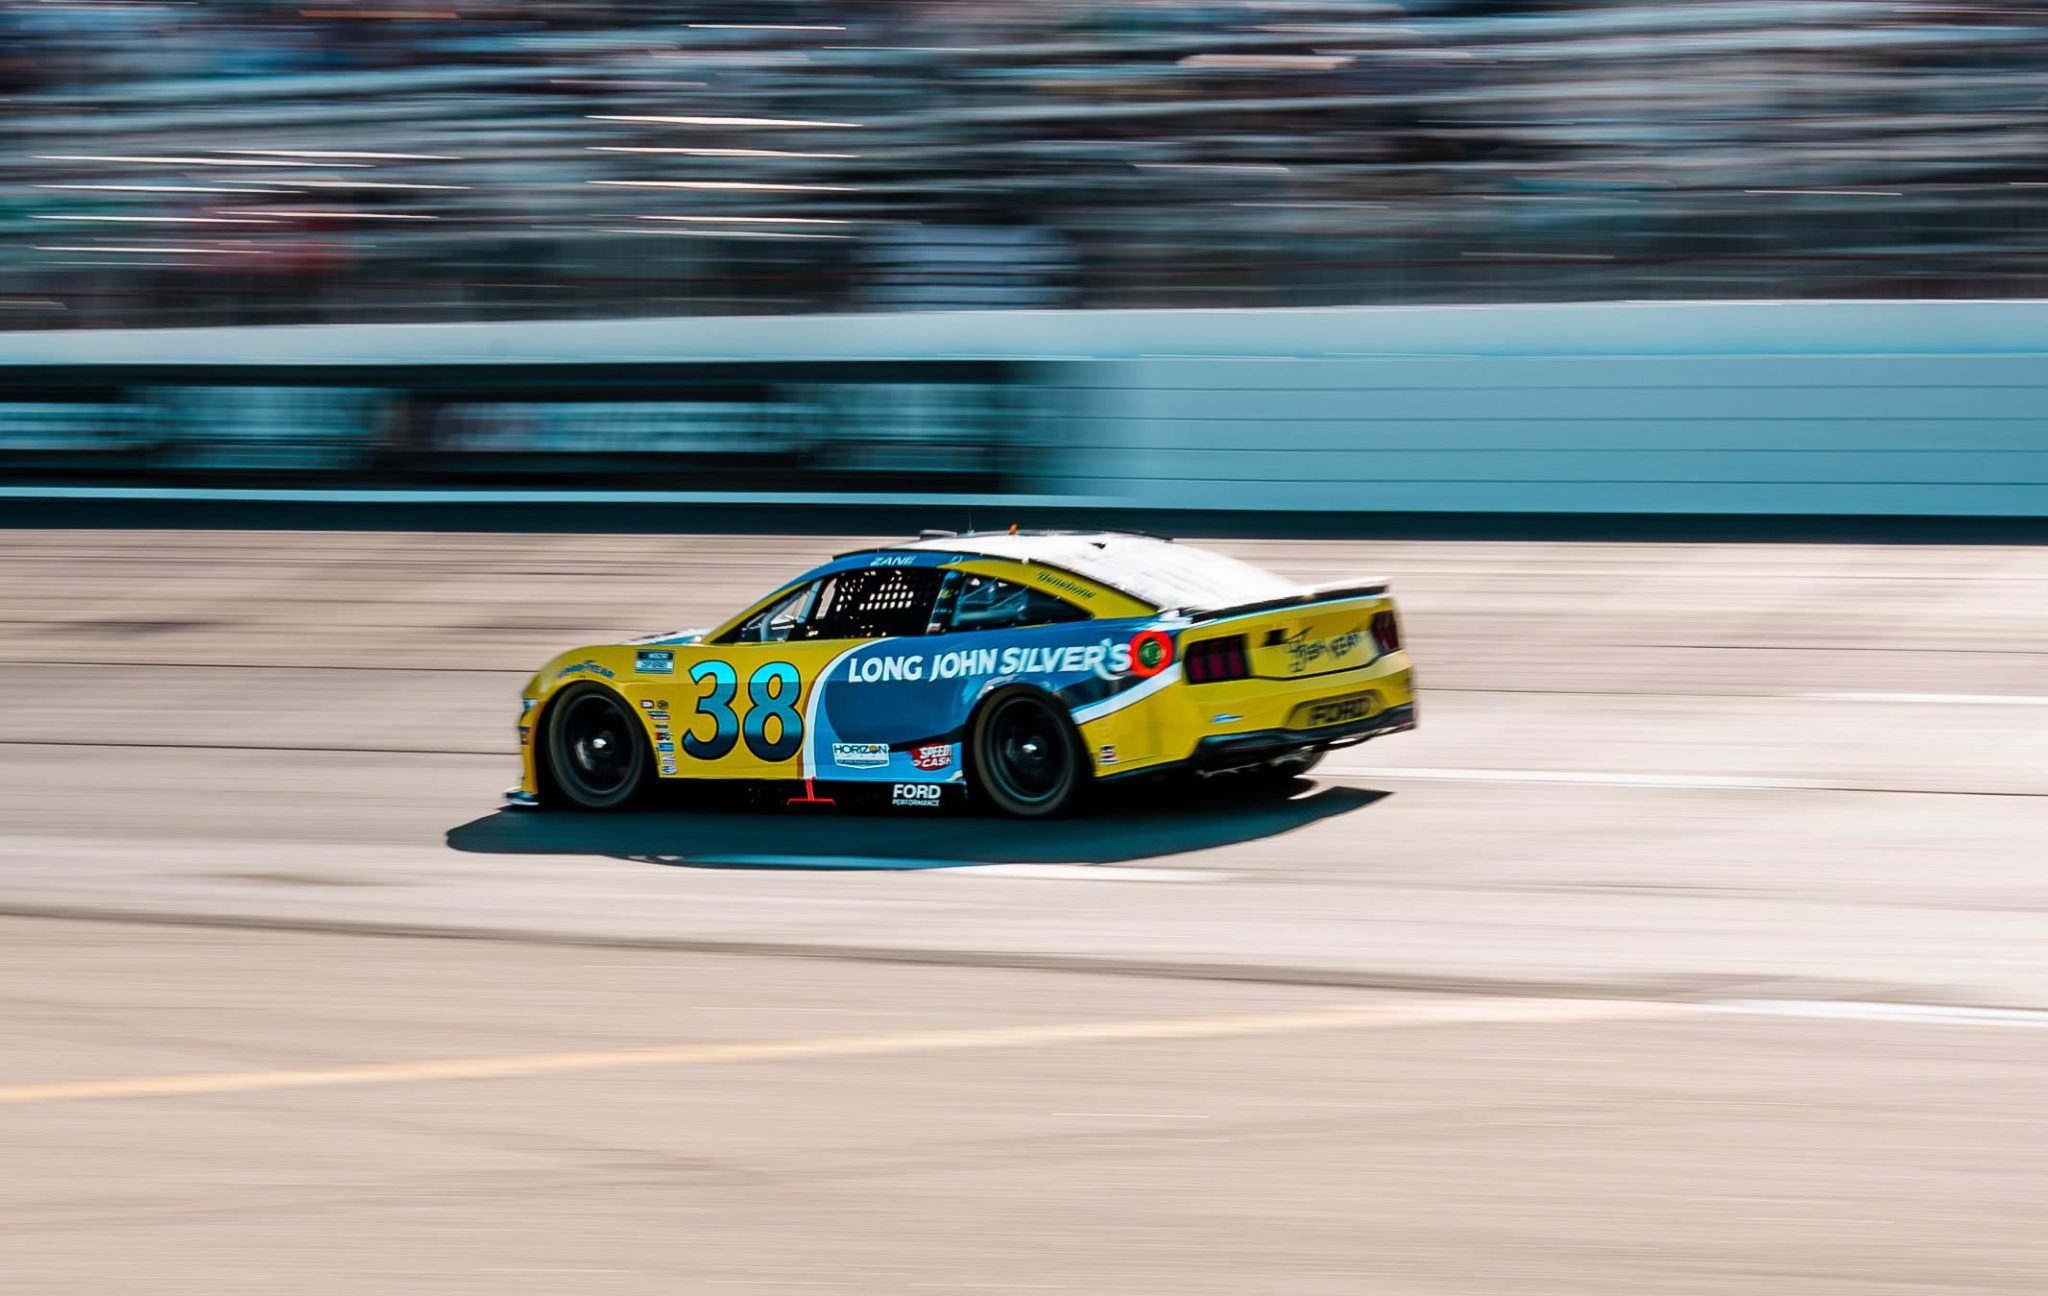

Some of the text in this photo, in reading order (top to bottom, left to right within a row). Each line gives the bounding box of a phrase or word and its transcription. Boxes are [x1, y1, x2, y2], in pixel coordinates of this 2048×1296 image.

[869, 555, 917, 567] ZANE
[848, 637, 1133, 683] LONG JOHN SILVER'S
[681, 659, 805, 763] 38
[1307, 697, 1372, 727] FORD
[834, 744, 888, 755] HORIZON
[921, 757, 952, 768] CASH
[892, 784, 942, 799] FORD
[892, 799, 940, 807] PERFORMANCE
